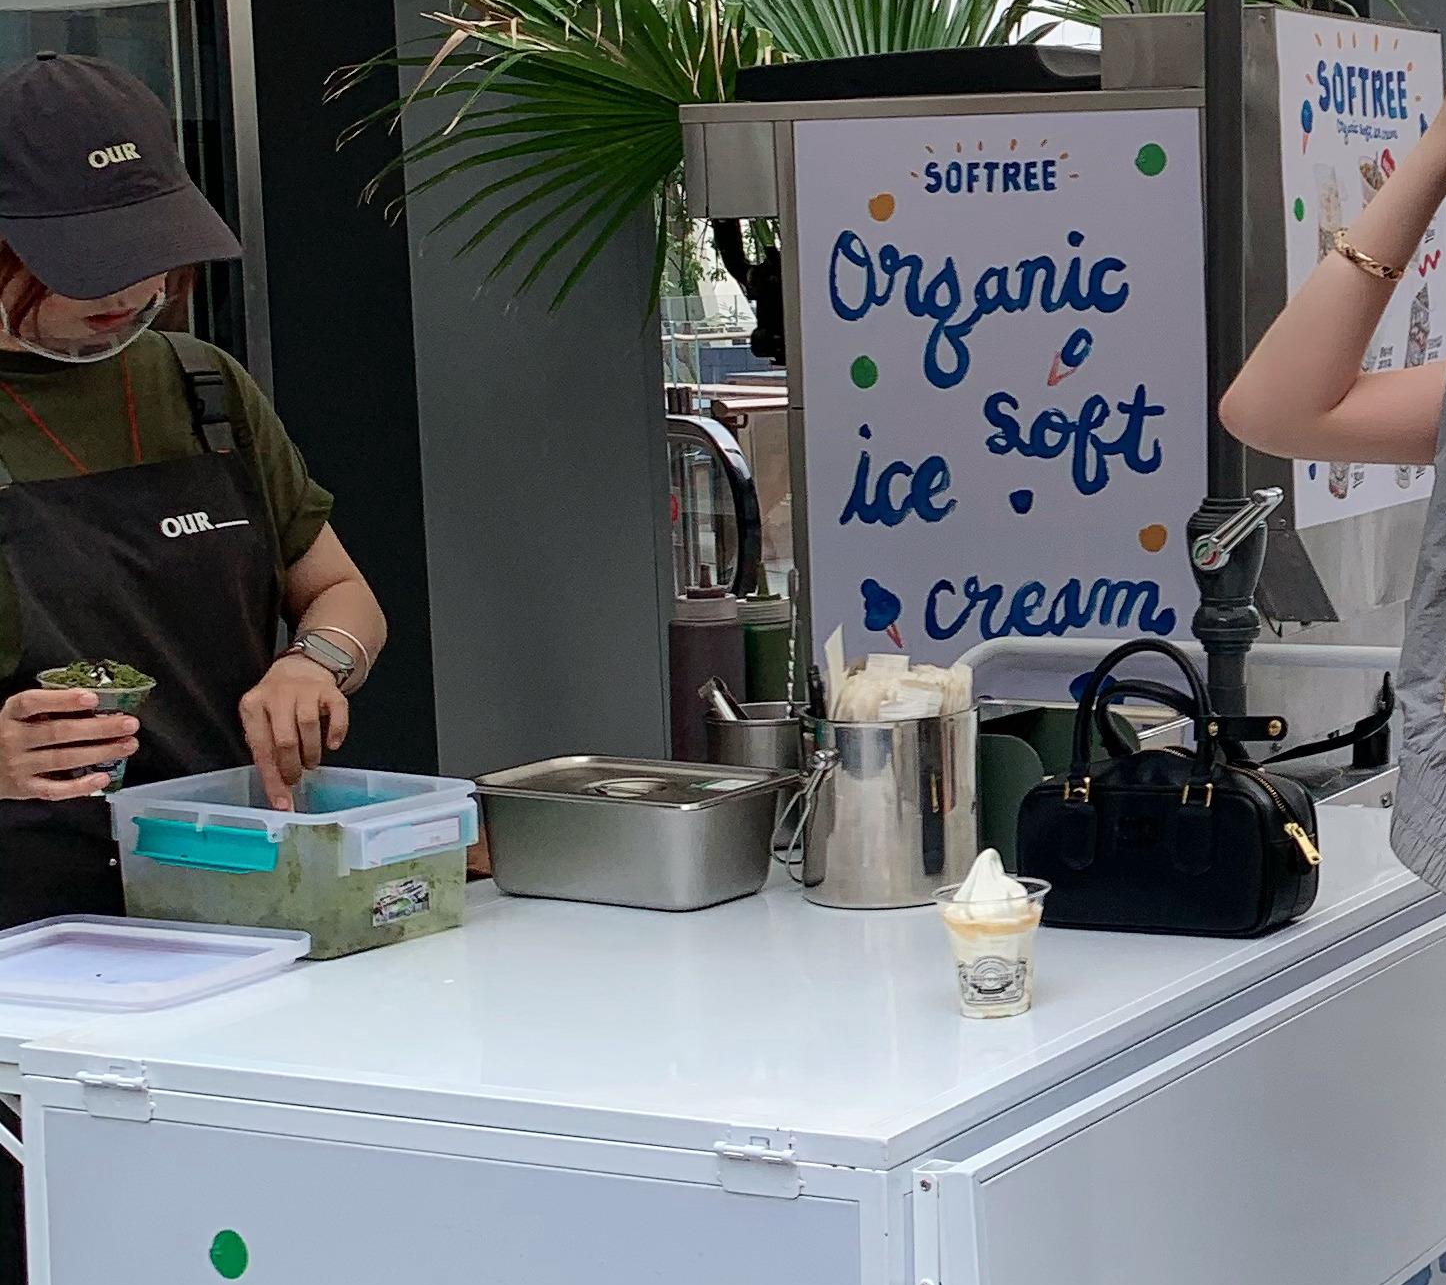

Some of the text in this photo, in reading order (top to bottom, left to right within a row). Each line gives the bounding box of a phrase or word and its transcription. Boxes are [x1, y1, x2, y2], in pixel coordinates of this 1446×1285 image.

[1316, 59, 1409, 120] SOFTREE
[87, 142, 142, 169] OUR
[923, 157, 1059, 193] SOFTREE
[829, 229, 1130, 389] Organic
[983, 383, 1166, 496] soft
[838, 422, 960, 528] ice
[924, 574, 1178, 641] cream
